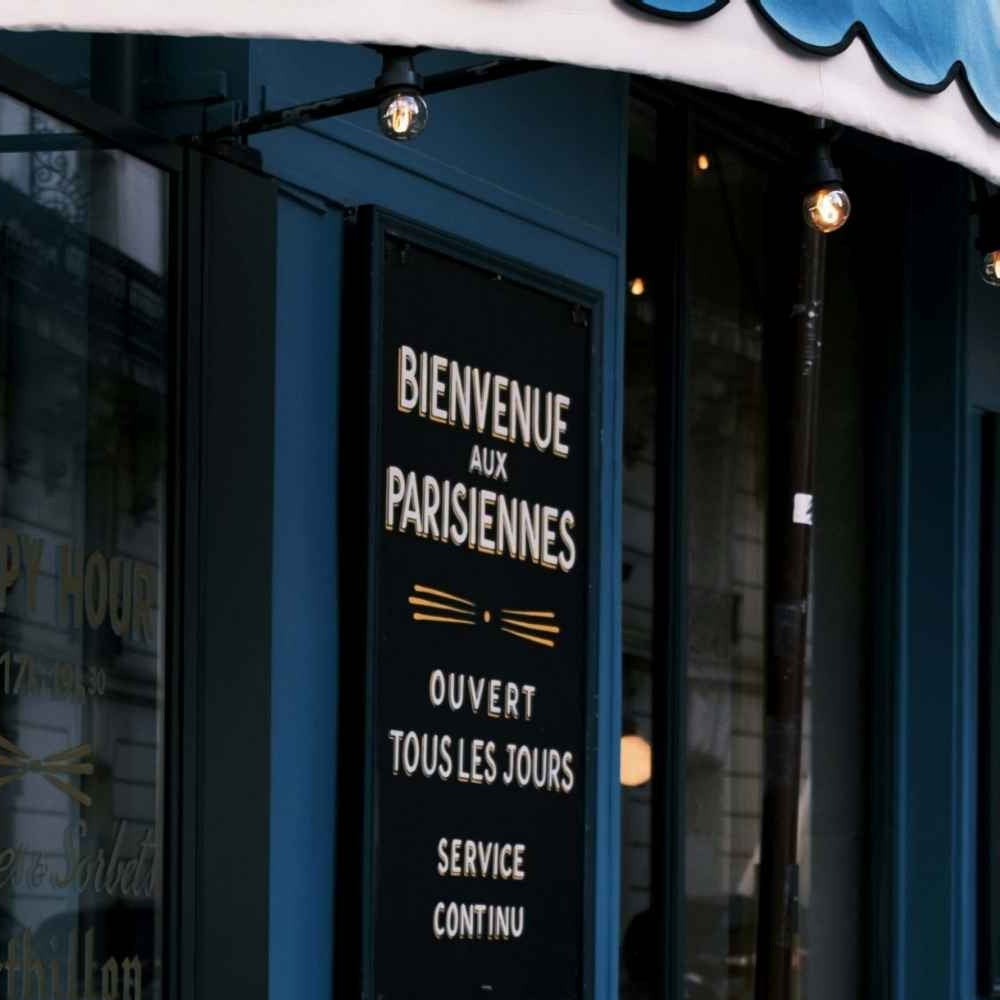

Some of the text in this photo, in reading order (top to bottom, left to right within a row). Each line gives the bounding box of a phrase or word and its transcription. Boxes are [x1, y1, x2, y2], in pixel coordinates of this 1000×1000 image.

[397, 345, 571, 458] BIENVENUE
[468, 444, 508, 482] AUX
[384, 465, 576, 572] PARISIENNES
[56, 544, 156, 643] HOUR
[428, 669, 536, 721] OUVERT
[389, 729, 574, 794] TOUS LES JOURS
[437, 837, 526, 881] SERVICE
[432, 901, 524, 940] CONTINU
